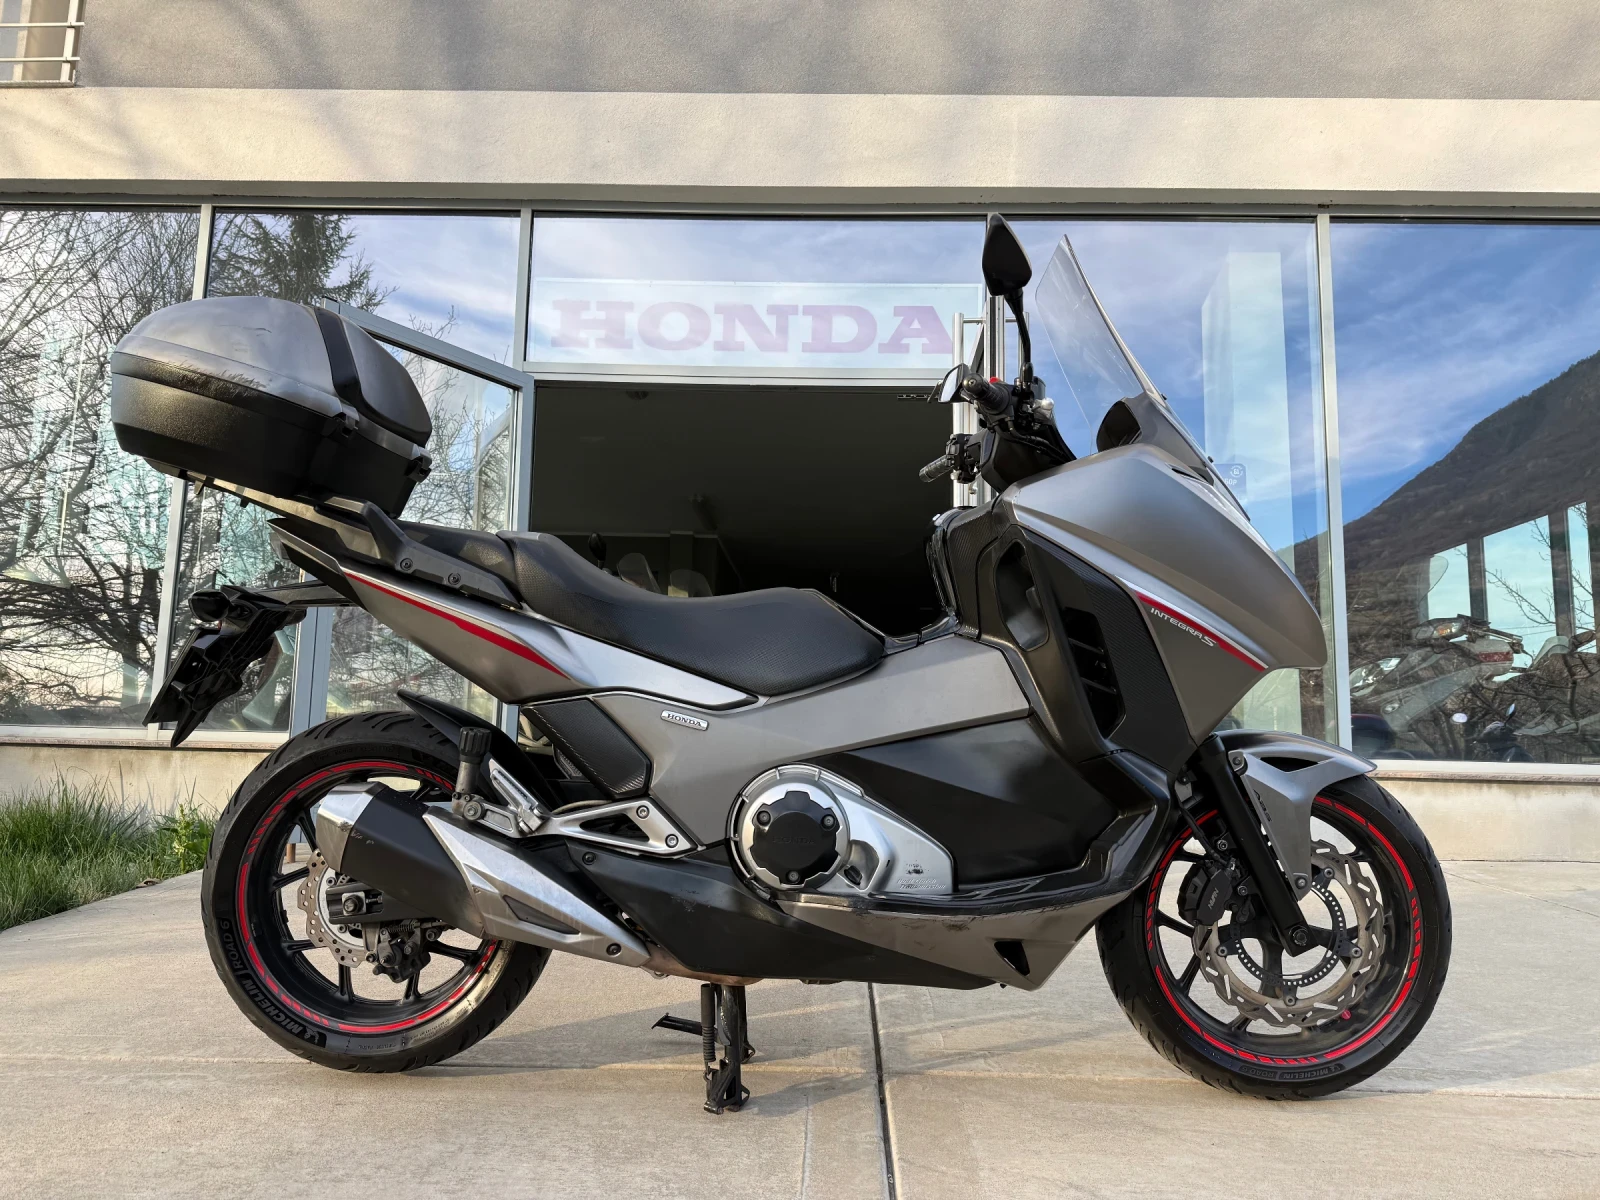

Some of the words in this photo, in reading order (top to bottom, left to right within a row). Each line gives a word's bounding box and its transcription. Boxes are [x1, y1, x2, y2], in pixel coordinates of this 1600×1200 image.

[551, 299, 953, 354] HONDA
[667, 713, 702, 727] HONDA
[220, 920, 230, 930] 6
[223, 932, 243, 969] ROAD
[242, 978, 304, 1034] MICHELIN
[1282, 1068, 1329, 1080] MICHELIN
